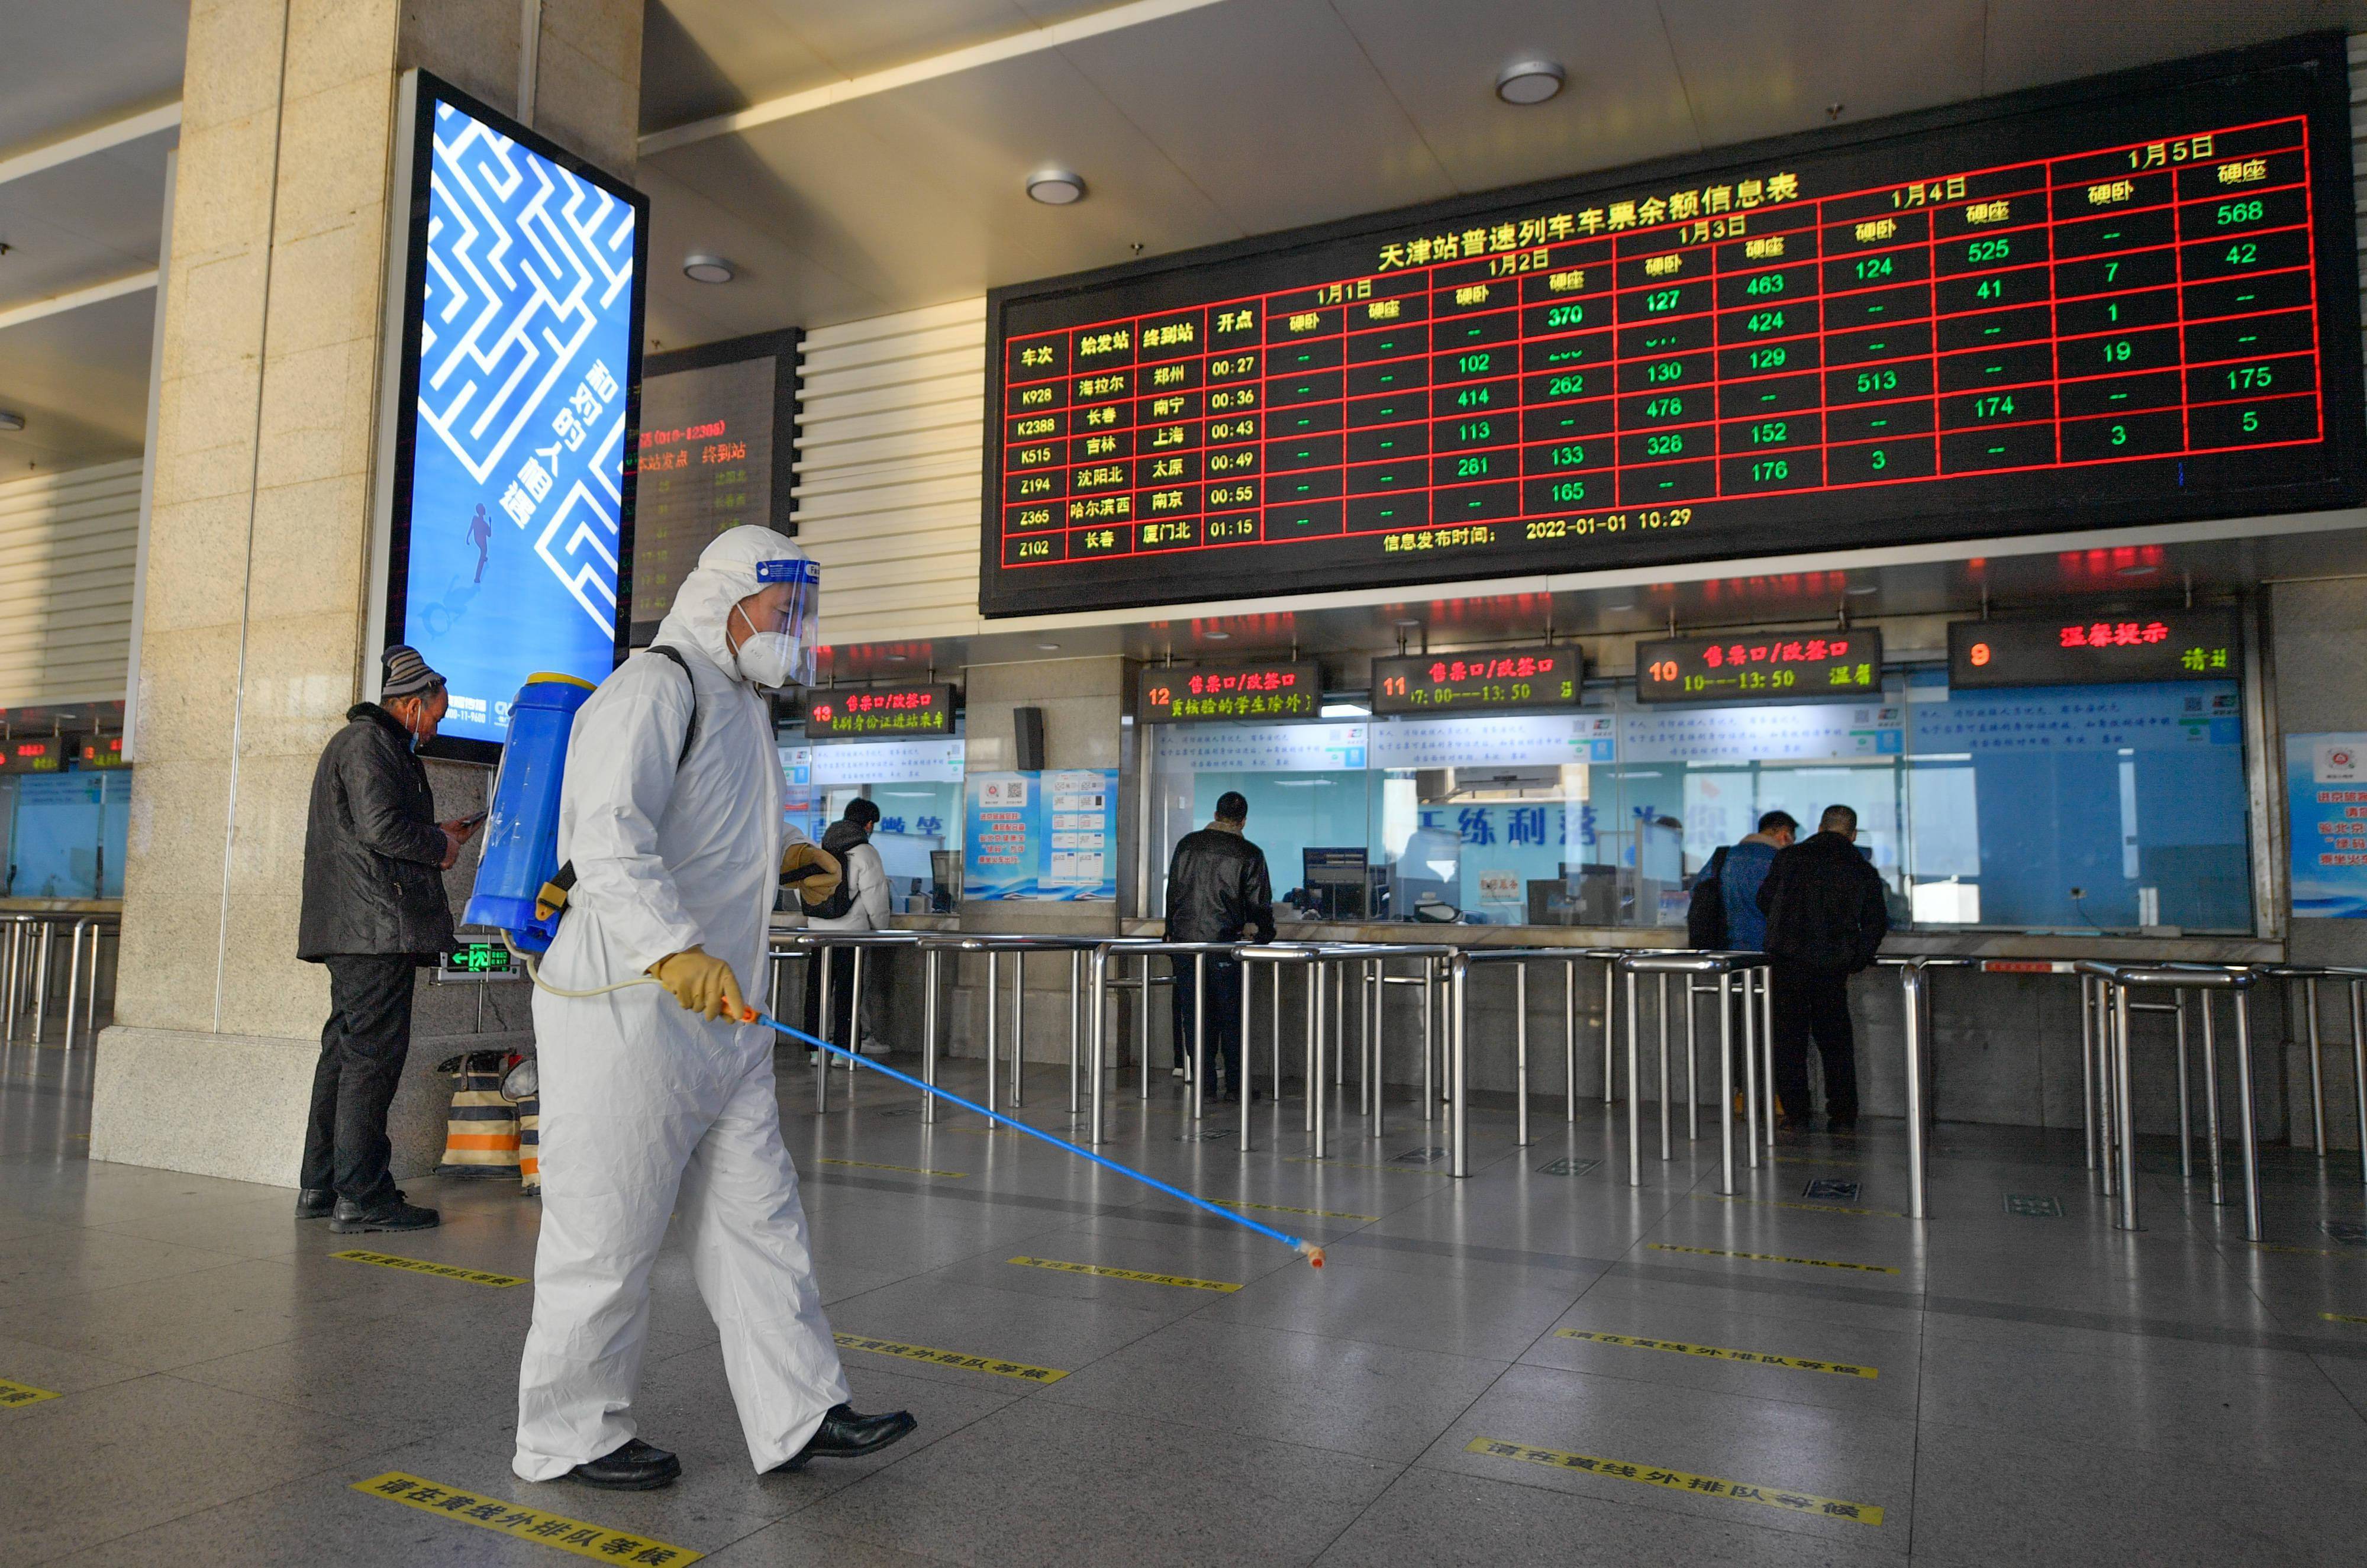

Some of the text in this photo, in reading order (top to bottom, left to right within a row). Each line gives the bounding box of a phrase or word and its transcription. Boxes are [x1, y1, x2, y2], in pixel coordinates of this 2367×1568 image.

[1317, 135, 2213, 305] 1月1日 1月2日 1月3日 1月4日 1月5日
[1378, 172, 1798, 272] 天津站普速列车车票余额信息表
[1021, 159, 2266, 367] 车次 始发站 终到站 开点 硬卧 硬座 硬卧 硬座 硬卧 硬座 硬卧 硬座 硬卧 硬座
[1022, 388, 1052, 405] K928
[1078, 375, 1124, 397] 海拉尔
[1153, 364, 1184, 385] 郑州
[1211, 356, 1255, 377] 00:27
[1547, 305, 1583, 327] 370
[1646, 289, 1681, 312] 127
[1746, 273, 1784, 296] 463
[1856, 257, 1894, 280] 124
[1968, 238, 2010, 263] 525
[2217, 200, 2263, 225] 568
[1017, 418, 1055, 436] K2388
[1086, 406, 1117, 426] 长春
[1153, 396, 1185, 417] 南宁
[1211, 389, 1255, 409] 00:36
[1459, 353, 1490, 373] 102
[1747, 311, 1785, 333] 424
[1976, 279, 2001, 299] 41
[2105, 262, 2118, 282] 7
[2225, 243, 2256, 264] 42
[1021, 447, 1051, 464] K515
[1086, 435, 1117, 456] 吉林
[1153, 425, 1184, 447] 上海
[1211, 420, 1254, 440] 00:43
[1457, 387, 1490, 407] 414
[1549, 375, 1584, 396] 262
[1647, 362, 1682, 383] 130
[1749, 347, 1786, 370] 129
[2108, 303, 2117, 322] 1
[499, 358, 619, 530] 和对的人相遇
[1020, 477, 1051, 495] Z194
[1077, 465, 1124, 488] 沈阳北
[1152, 458, 1184, 479] 太原
[1211, 451, 1253, 471] 00:49
[1459, 421, 1491, 441] 113
[1646, 397, 1682, 418] 478
[1857, 370, 1897, 393] 513
[2103, 341, 2131, 363] 19
[1020, 509, 1050, 527] Z365
[1070, 496, 1131, 520] 哈尔滨西
[1152, 490, 1184, 511] 南京
[1210, 485, 1253, 505] 00:55
[1457, 457, 1488, 477] 281
[1552, 445, 1584, 466] 133
[1647, 434, 1684, 456] 328
[1751, 422, 1787, 444] 152
[1975, 395, 2015, 418] 174
[2227, 366, 2272, 390] 175
[1019, 540, 1049, 557] Z102
[1084, 530, 1115, 549] 长春
[1142, 521, 1191, 544] 厦门北
[1210, 518, 1253, 537] 01:15
[1552, 482, 1585, 502] 165
[1752, 460, 1788, 482] 176
[1872, 450, 1886, 470] 3
[2111, 425, 2126, 445] 3
[2243, 411, 2258, 431] 5
[1526, 514, 1626, 540] 2022-01-01
[1639, 508, 1692, 529] 10:29
[1703, 640, 1849, 668] 售票口/改签口
[1970, 643, 1991, 666] 9
[2059, 621, 2169, 648] 温馨提示
[1149, 688, 1170, 705] 12
[1188, 672, 1296, 694] 售票口/改签口
[1383, 676, 1405, 696] 11
[1428, 657, 1554, 683] 售票口/改签口
[1649, 660, 1679, 682] 10
[813, 705, 833, 722] 13
[846, 692, 932, 712] 售票口/改签口
[1568, 1330, 1861, 1375] 请在黄线外排队等候
[1486, 1442, 1861, 1519] 请在黄线外排队等候
[373, 1478, 679, 1566] 请在黄线外排队等候
